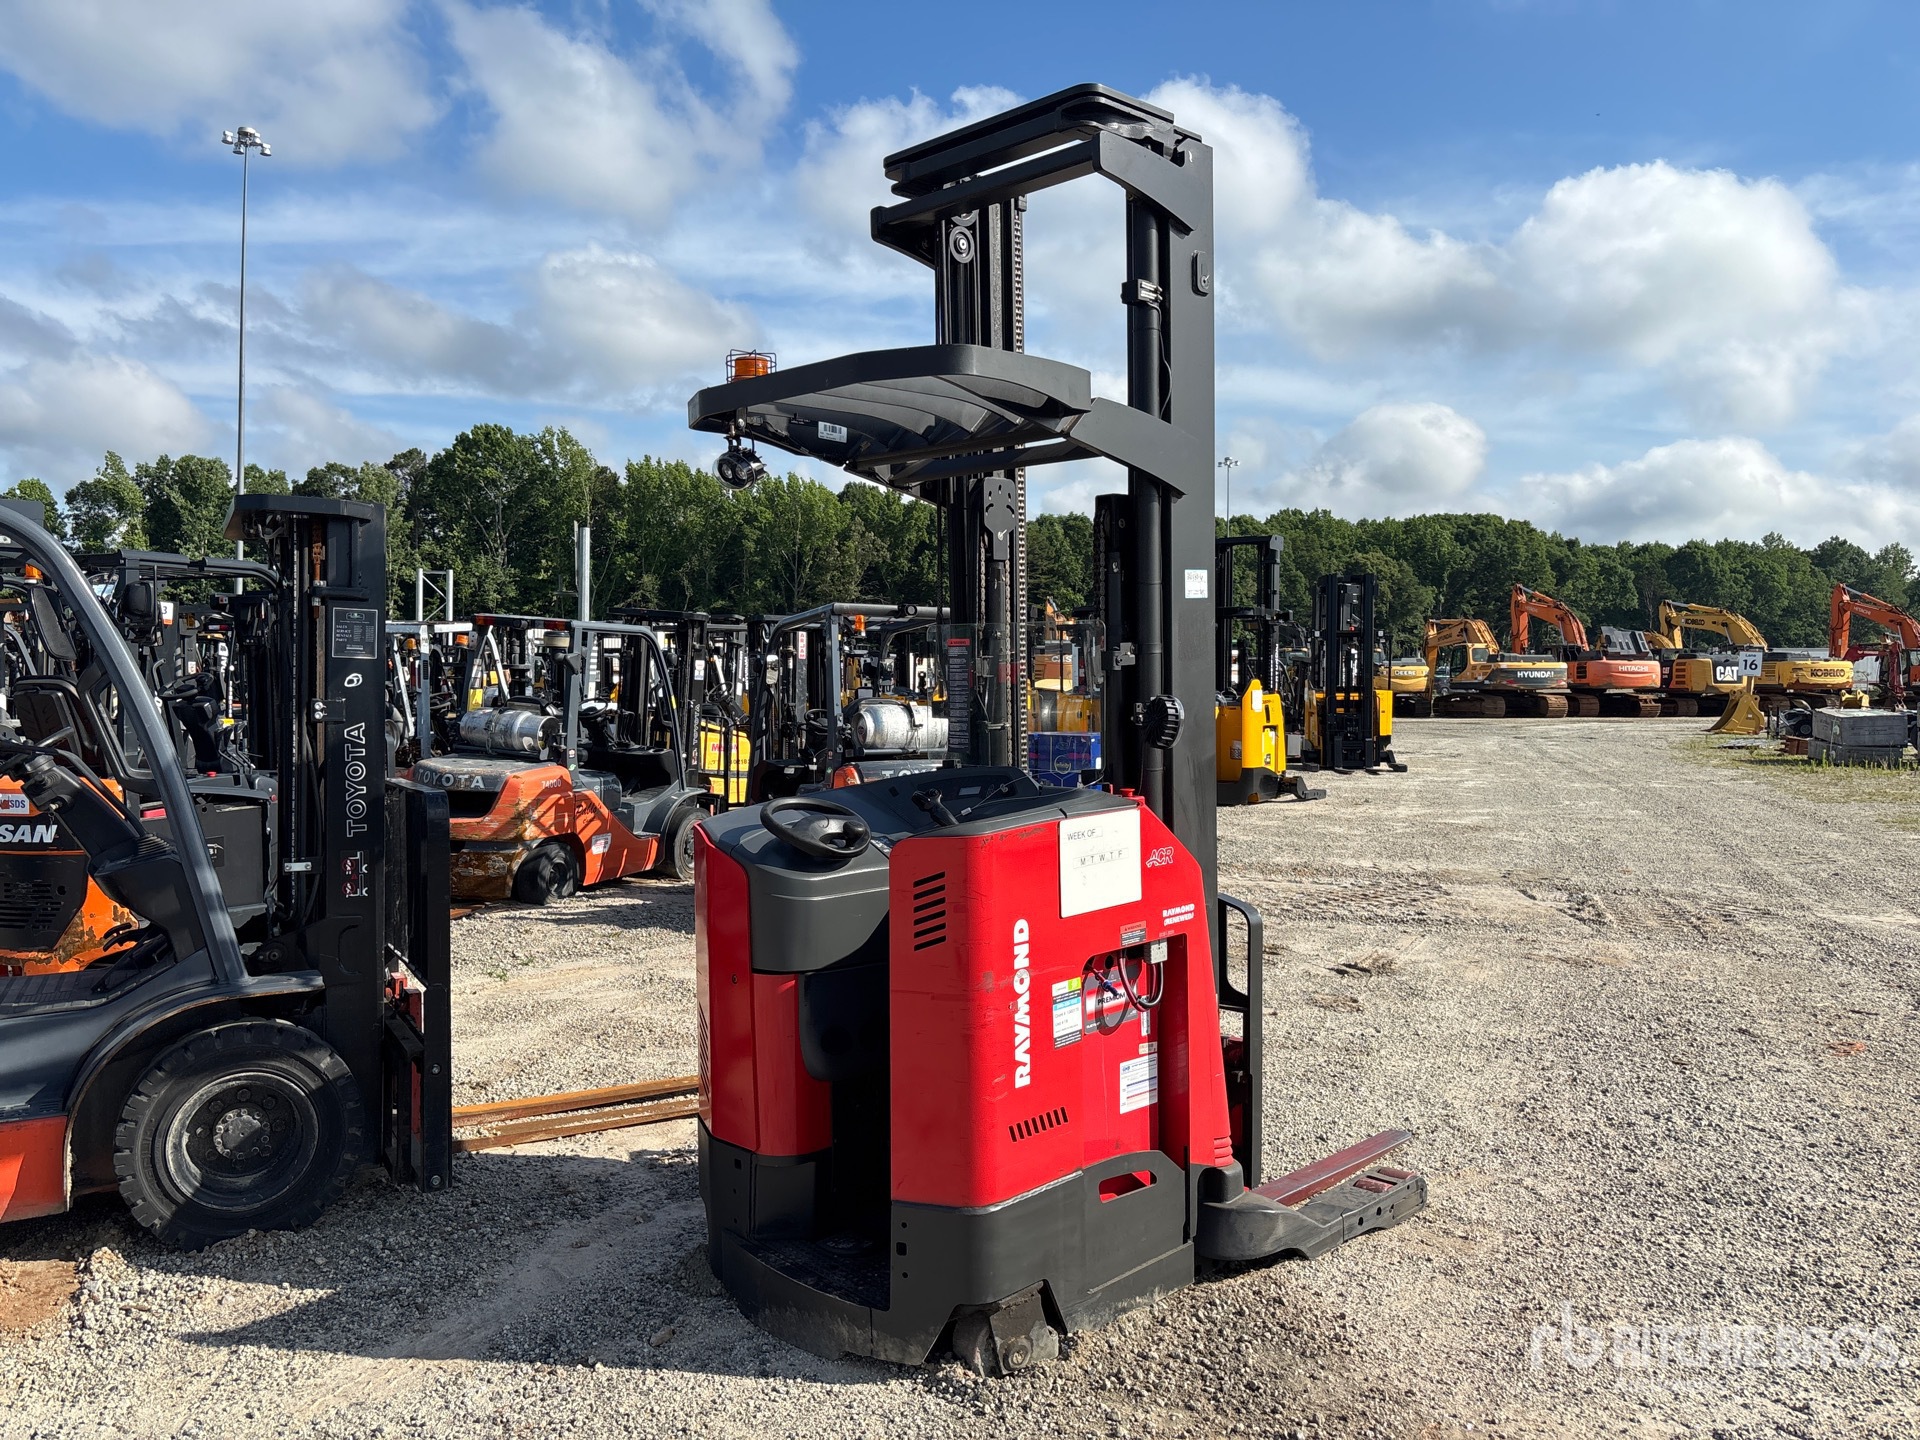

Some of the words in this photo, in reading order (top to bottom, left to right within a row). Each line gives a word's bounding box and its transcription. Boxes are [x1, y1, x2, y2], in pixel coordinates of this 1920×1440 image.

[1743, 659, 1758, 670] 16
[1517, 671, 1554, 679] HYUNDAI
[1716, 666, 1739, 681] CAT
[1810, 668, 1846, 678] KOBELCO
[344, 722, 368, 837] TOYOTA
[417, 768, 485, 790] TOYOTA
[541, 779, 562, 789] 74000
[1067, 831, 1086, 841] WEEK
[1087, 829, 1096, 838] OF
[1080, 857, 1086, 866] M
[1090, 855, 1095, 864] T
[1098, 854, 1105, 862] W
[1110, 851, 1114, 860] T
[1118, 850, 1123, 858] F
[1146, 846, 1174, 868] ACR
[1162, 904, 1195, 917] RAYMOND
[1013, 918, 1031, 1089] RAYMOND
